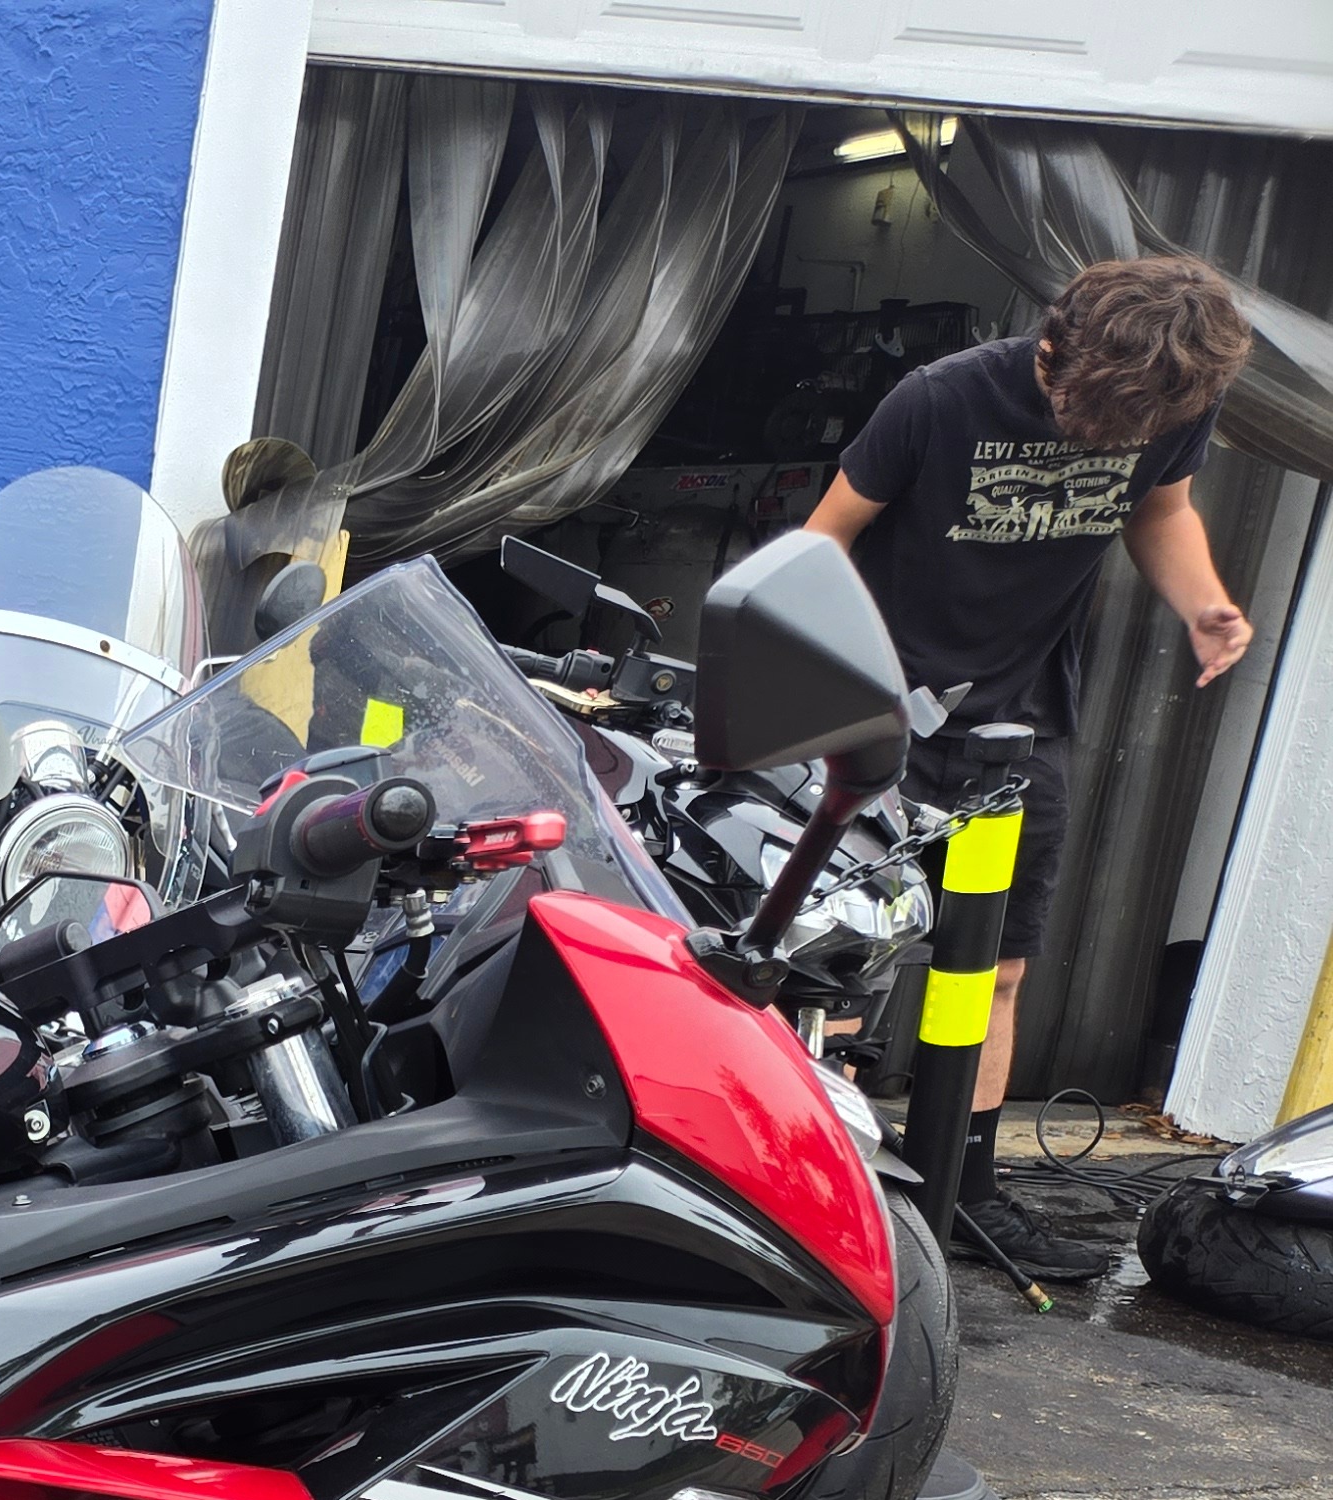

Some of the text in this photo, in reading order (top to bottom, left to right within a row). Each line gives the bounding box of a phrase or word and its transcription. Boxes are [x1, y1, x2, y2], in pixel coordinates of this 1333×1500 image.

[973, 440, 1015, 460] LEVI
[1019, 440, 1094, 459] STRAU
[977, 460, 1128, 485] ORIGINAL RIVETED
[991, 475, 1112, 498] QUALITY CLOTHING
[550, 1351, 785, 1469] Ninja 650
